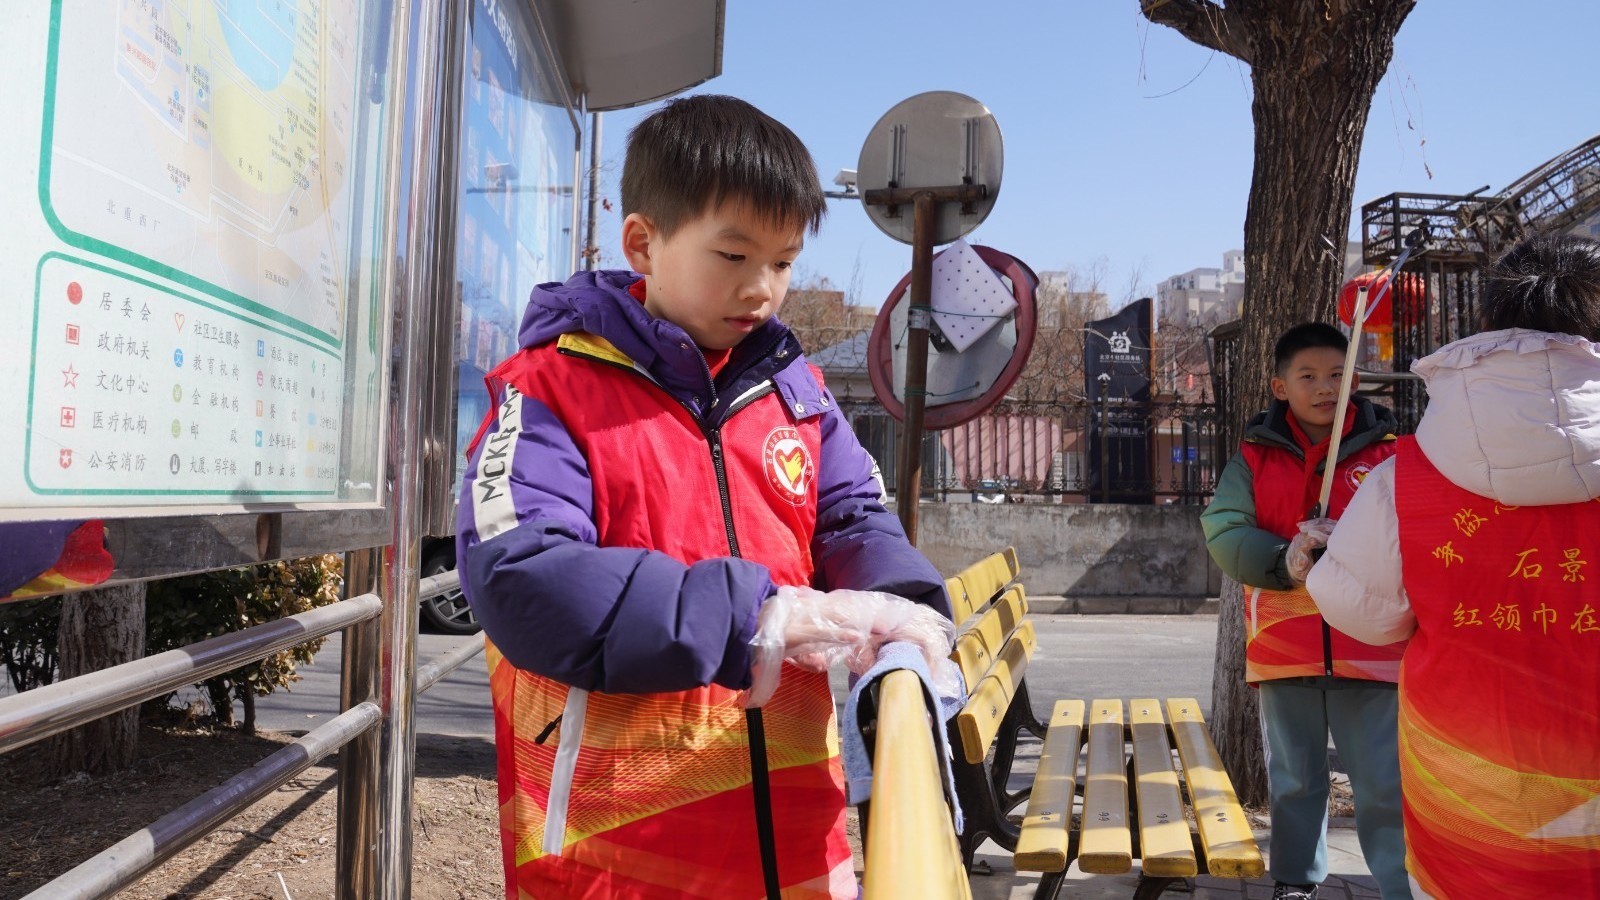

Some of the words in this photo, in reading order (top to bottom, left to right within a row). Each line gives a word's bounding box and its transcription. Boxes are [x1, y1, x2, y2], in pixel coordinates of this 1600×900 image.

[99, 292, 151, 321] 居委会
[97, 331, 150, 359] 政府机关
[193, 319, 240, 350] 社区卫生服务
[193, 353, 240, 381] 教育机构
[96, 369, 149, 394] 文化中心
[192, 388, 239, 413] 金融机构
[92, 411, 147, 434] 医疗机构
[88, 450, 147, 472] 公安消防
[1508, 547, 1588, 583] 石景
[1452, 602, 1600, 636] 红领巾在
